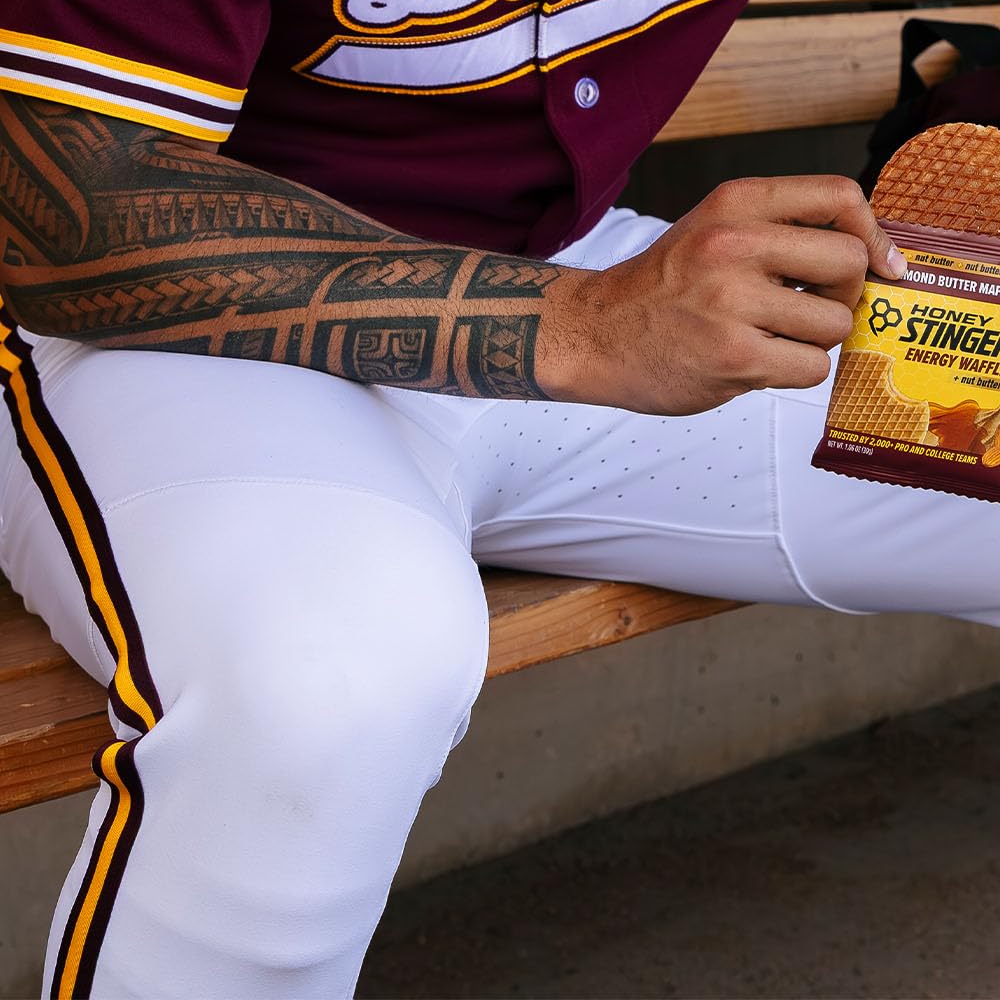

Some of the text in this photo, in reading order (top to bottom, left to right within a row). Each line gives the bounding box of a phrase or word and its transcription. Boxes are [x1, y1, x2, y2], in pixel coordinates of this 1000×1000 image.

[915, 254, 929, 263] nut
[930, 255, 955, 267] butter
[965, 262, 979, 271] nut
[901, 269, 936, 286] MOND
[938, 276, 976, 293] BUTTER
[910, 303, 995, 327] HONEY
[904, 347, 958, 369] ENERGY
[961, 375, 976, 385] nut
[828, 429, 978, 465] TRUSTED BY 2,000+ PRO AND COLLEGE TEAMS
